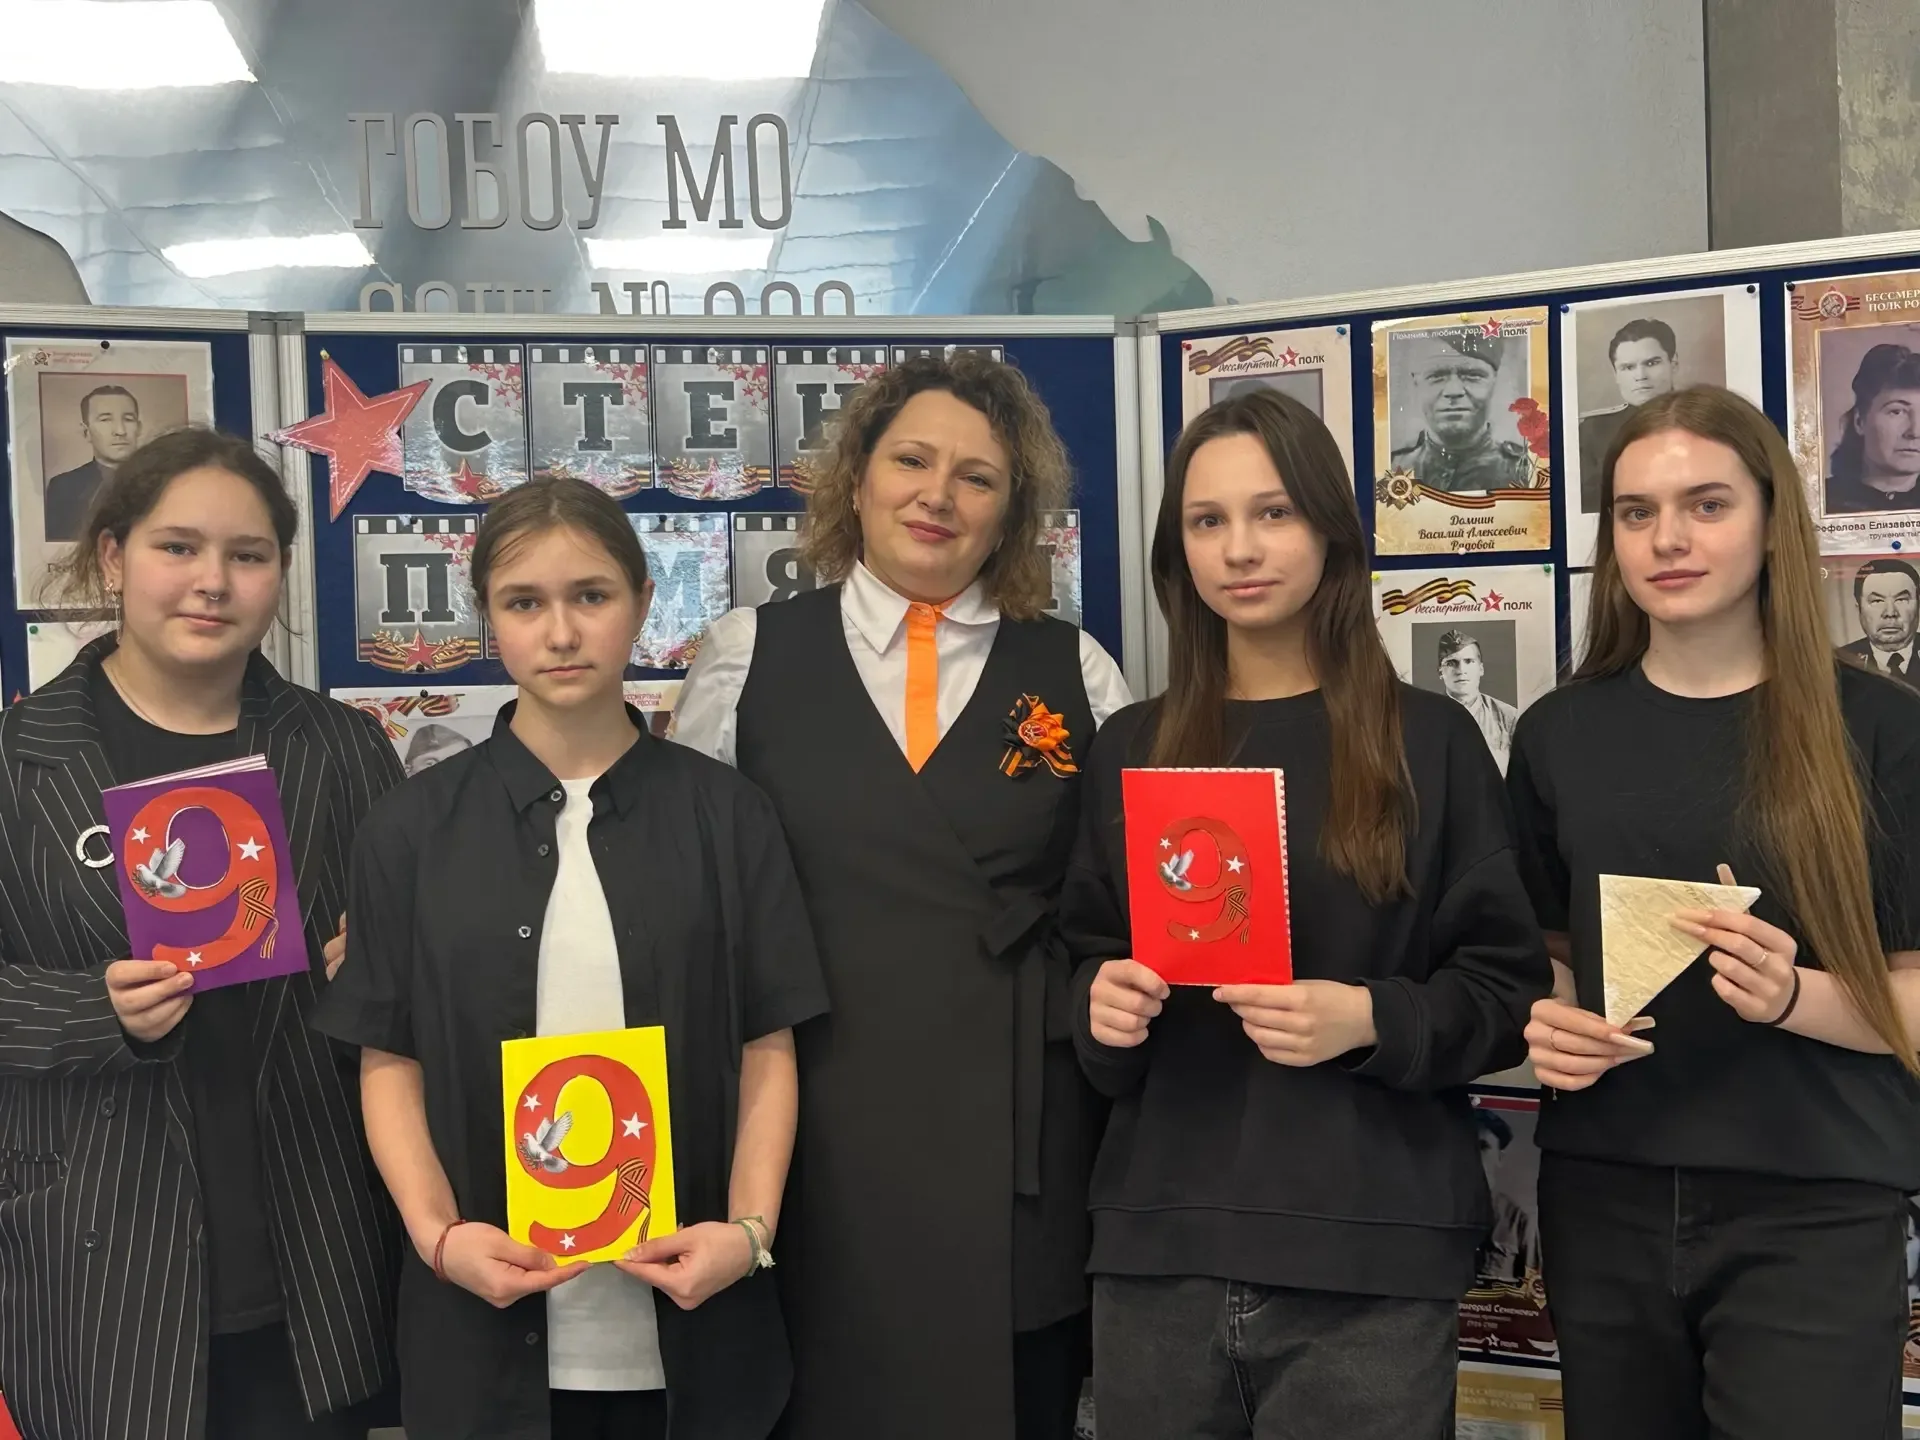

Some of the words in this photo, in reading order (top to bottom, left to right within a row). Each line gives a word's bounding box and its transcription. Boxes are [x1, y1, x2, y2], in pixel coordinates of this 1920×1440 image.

[348, 112, 619, 230] ГОБОУ
[656, 113, 792, 229] МО
[1869, 300, 1902, 312] ПОЛК
[1418, 528, 1464, 540] Василий
[1466, 525, 1528, 538] Алексеевич
[124, 787, 278, 972] 9
[1155, 817, 1253, 943] 9
[514, 1055, 656, 1256] 9
